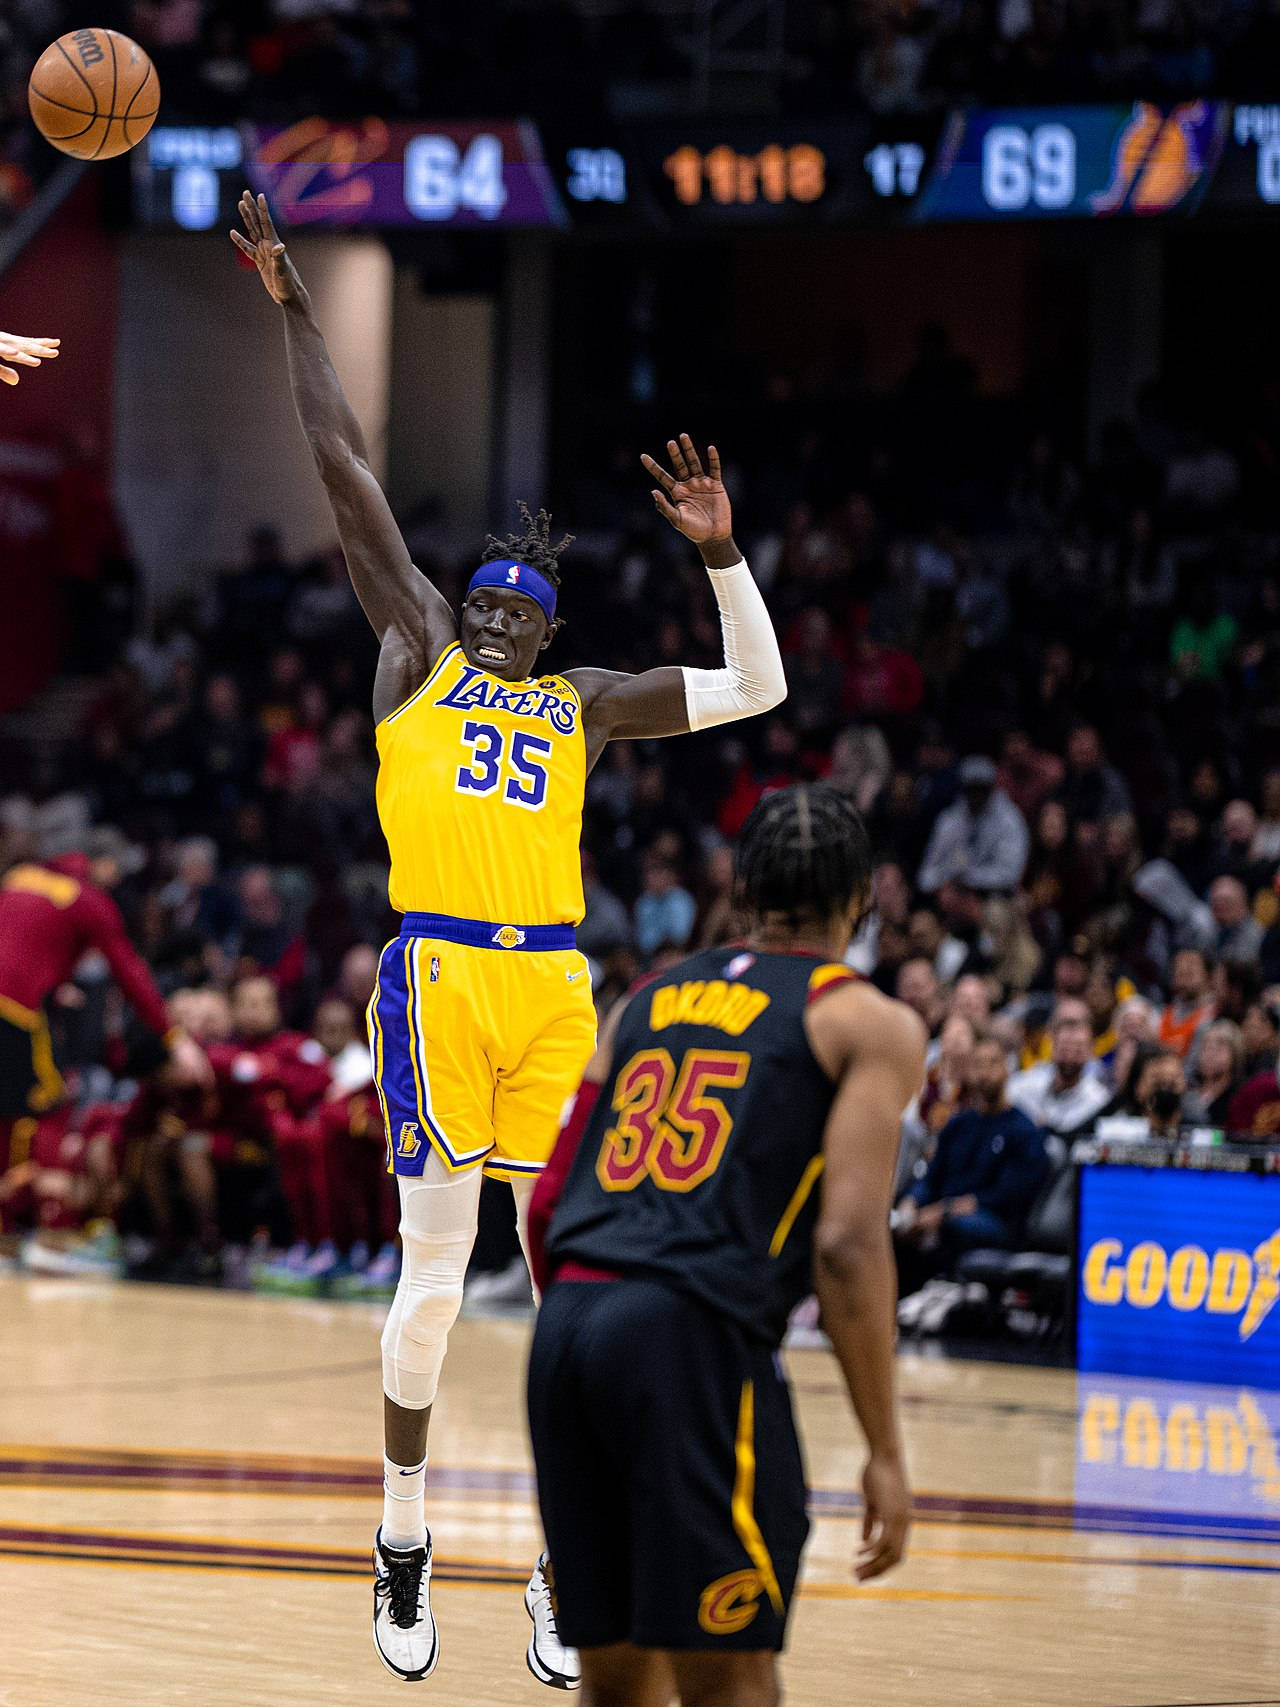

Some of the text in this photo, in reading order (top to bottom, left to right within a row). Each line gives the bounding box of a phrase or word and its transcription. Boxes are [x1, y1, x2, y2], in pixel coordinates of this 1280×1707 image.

[403, 133, 508, 221] 64
[863, 143, 925, 197] 17
[981, 124, 1077, 211] 69
[434, 666, 578, 735] LAKERS
[455, 719, 553, 813] 35
[595, 1047, 752, 1193] 35
